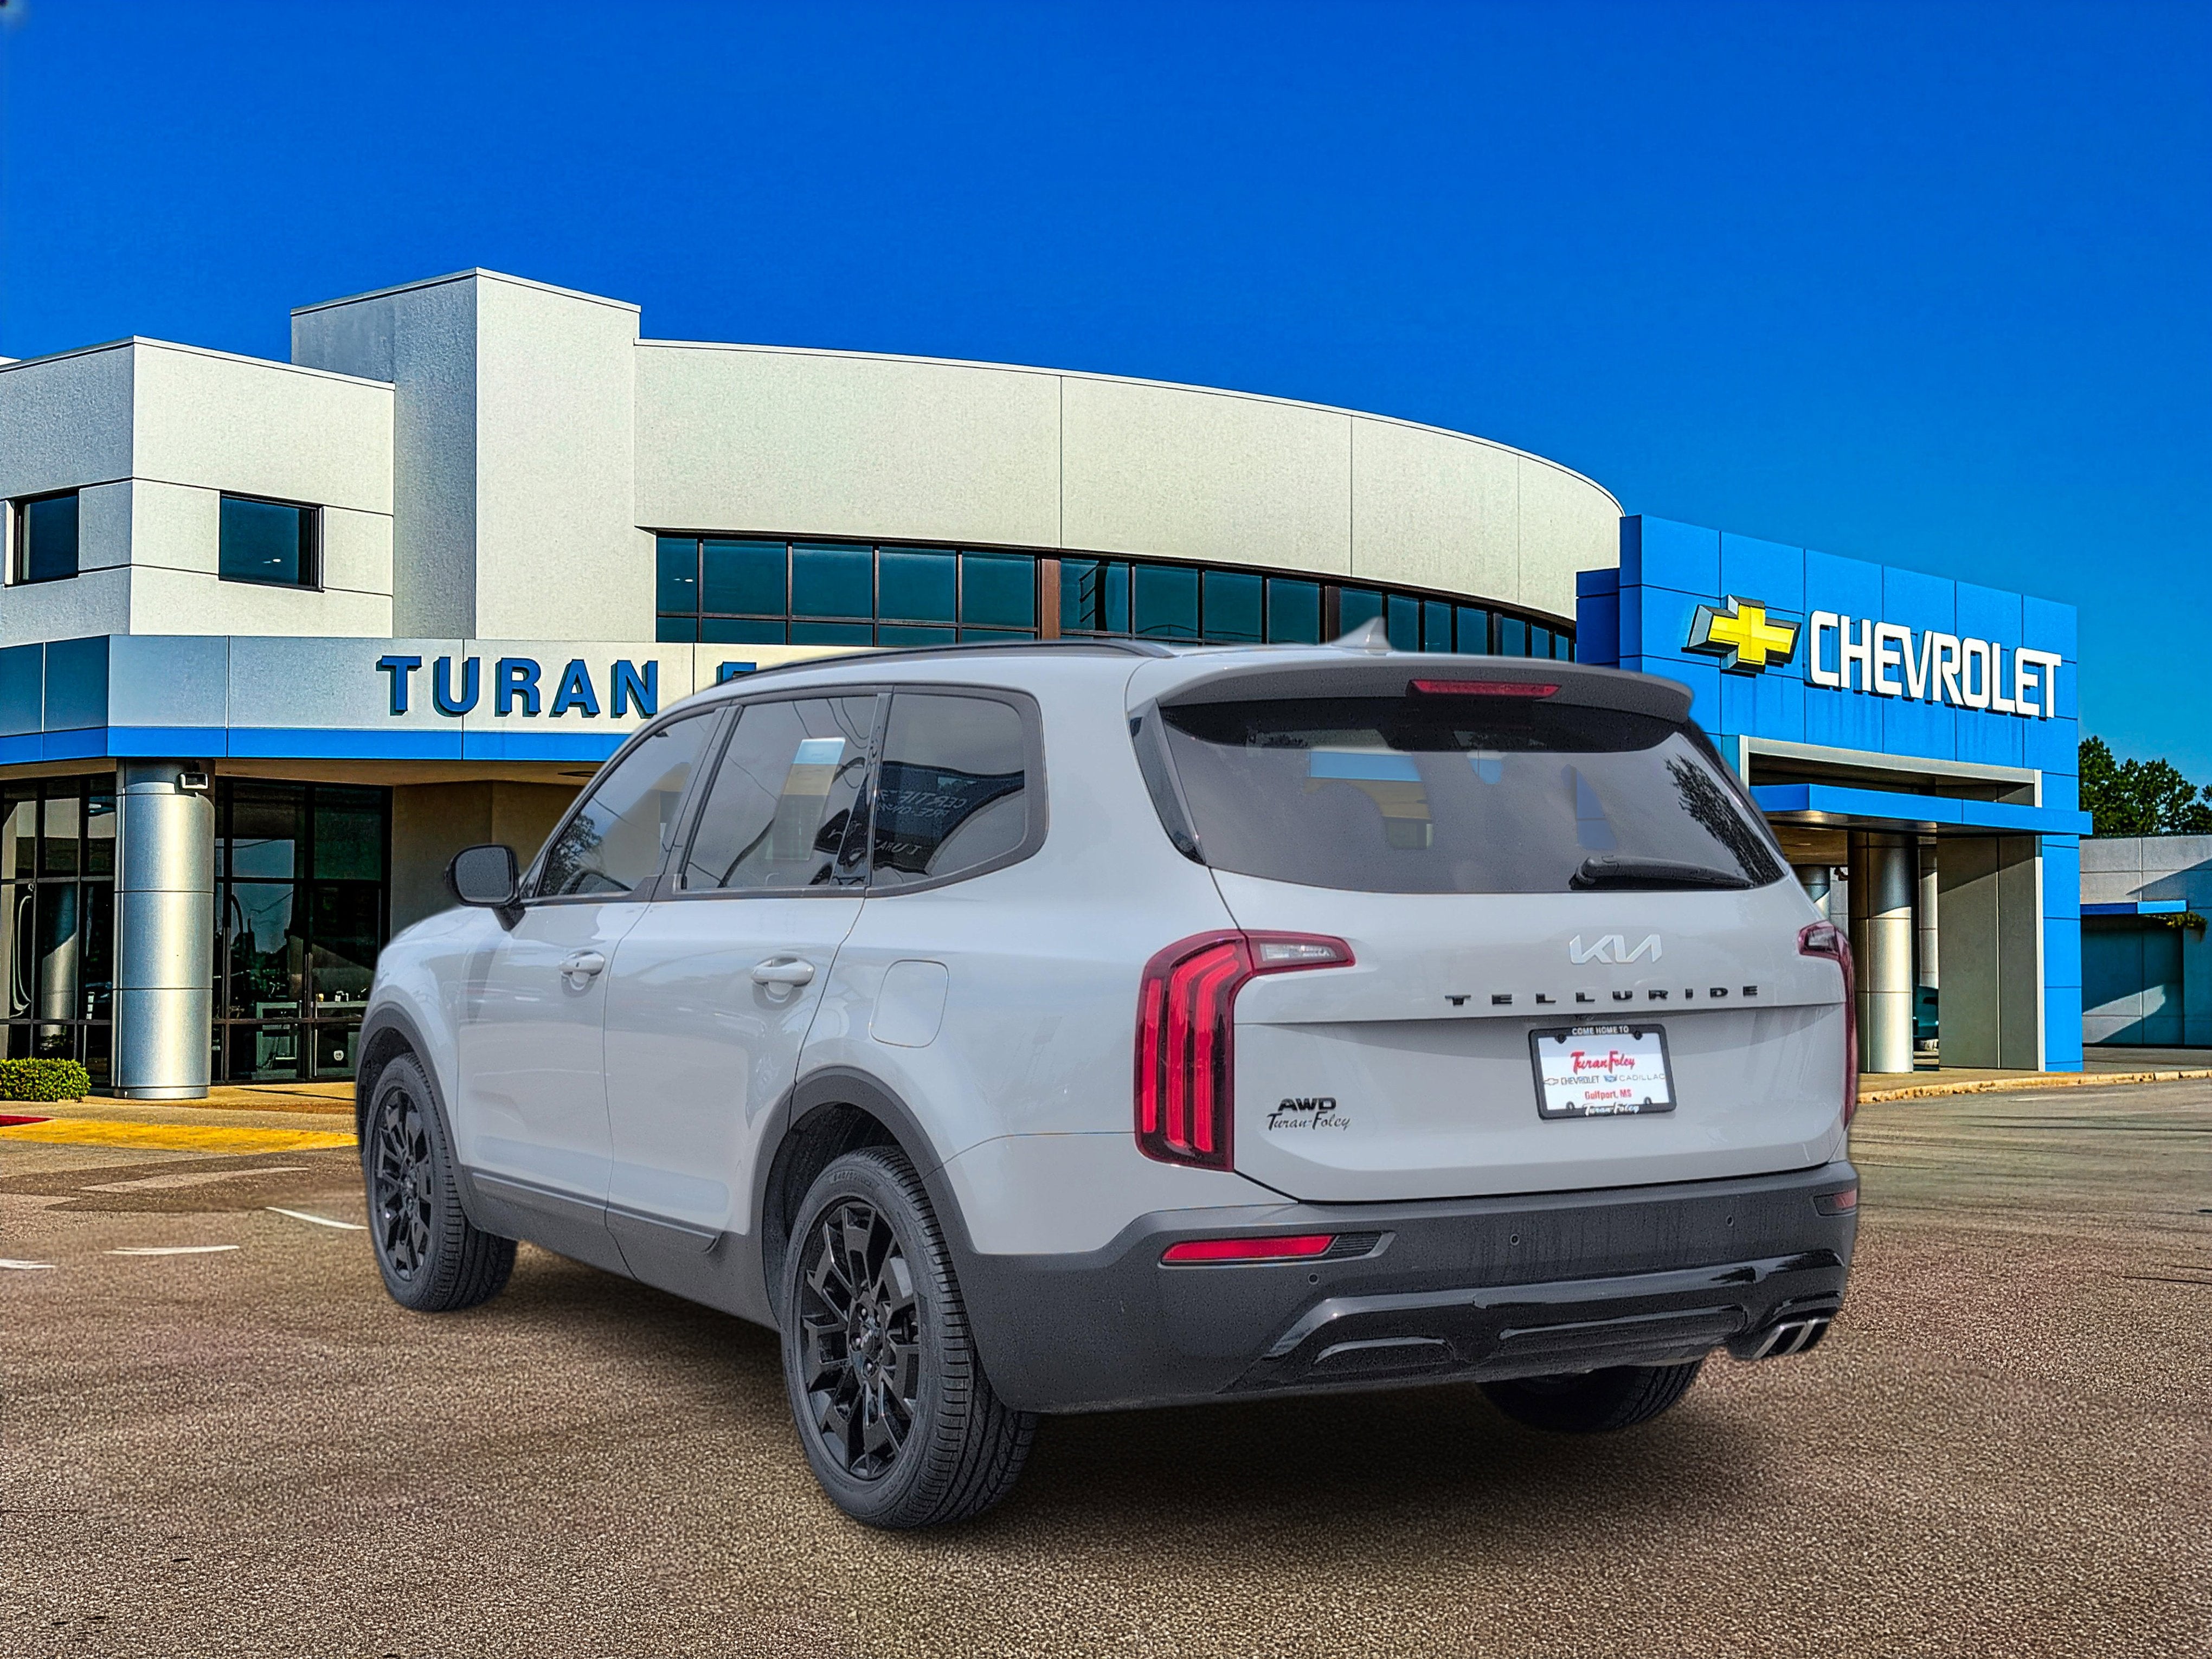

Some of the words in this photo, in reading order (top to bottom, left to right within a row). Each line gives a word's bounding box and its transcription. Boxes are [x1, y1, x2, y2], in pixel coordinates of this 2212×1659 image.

[1809, 610, 2062, 719] CHEVROLET
[376, 655, 659, 719] TURAN
[1569, 934, 1662, 964] KIA
[1445, 985, 1758, 1006] TELLURIDE
[1561, 1076, 1599, 1085] CHEVROLET
[1619, 1073, 1665, 1082] CADILLAC
[1619, 1089, 1632, 1098] MS
[1278, 1097, 1336, 1112] AWD
